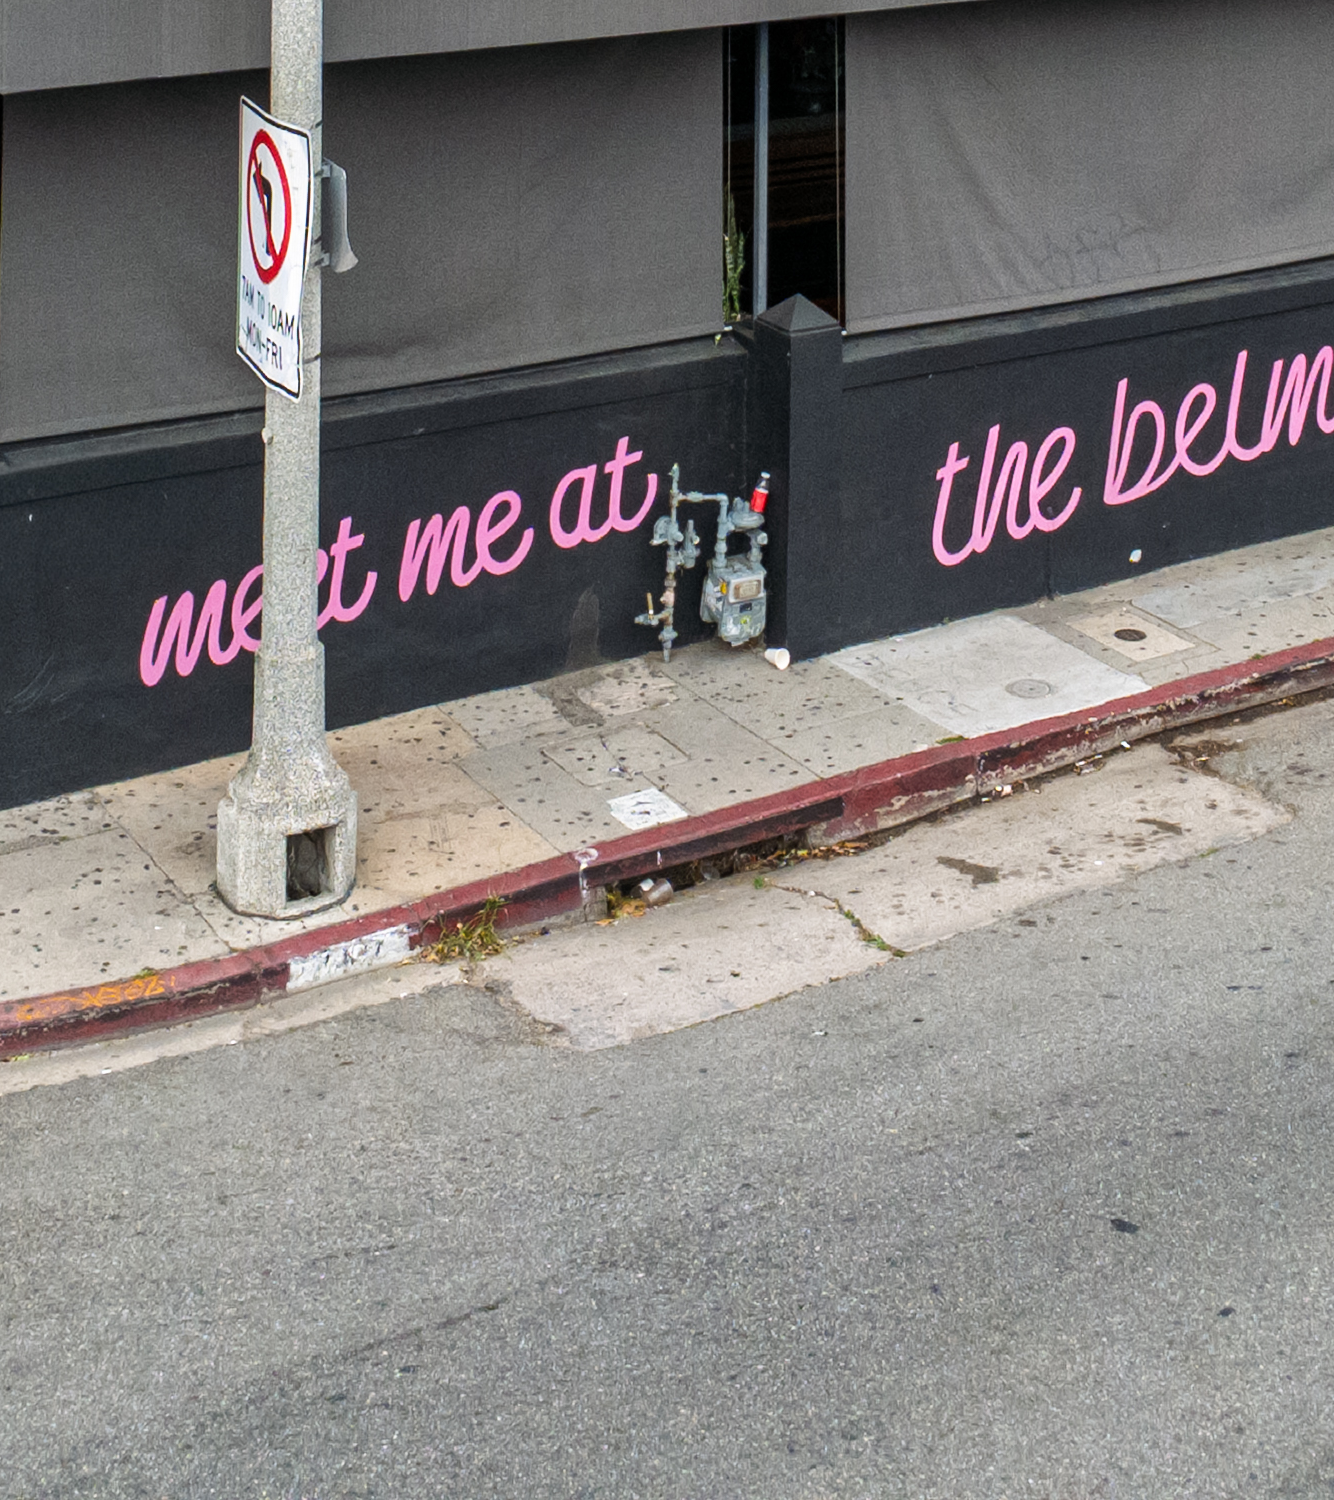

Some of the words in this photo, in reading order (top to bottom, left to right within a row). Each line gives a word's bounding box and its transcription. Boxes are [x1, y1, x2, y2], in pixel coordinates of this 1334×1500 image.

[257, 290, 265, 320] TO
[268, 302, 295, 340] 10AM
[140, 516, 377, 686] met
[398, 490, 534, 602] me
[549, 436, 658, 549] at
[932, 424, 1082, 566] the
